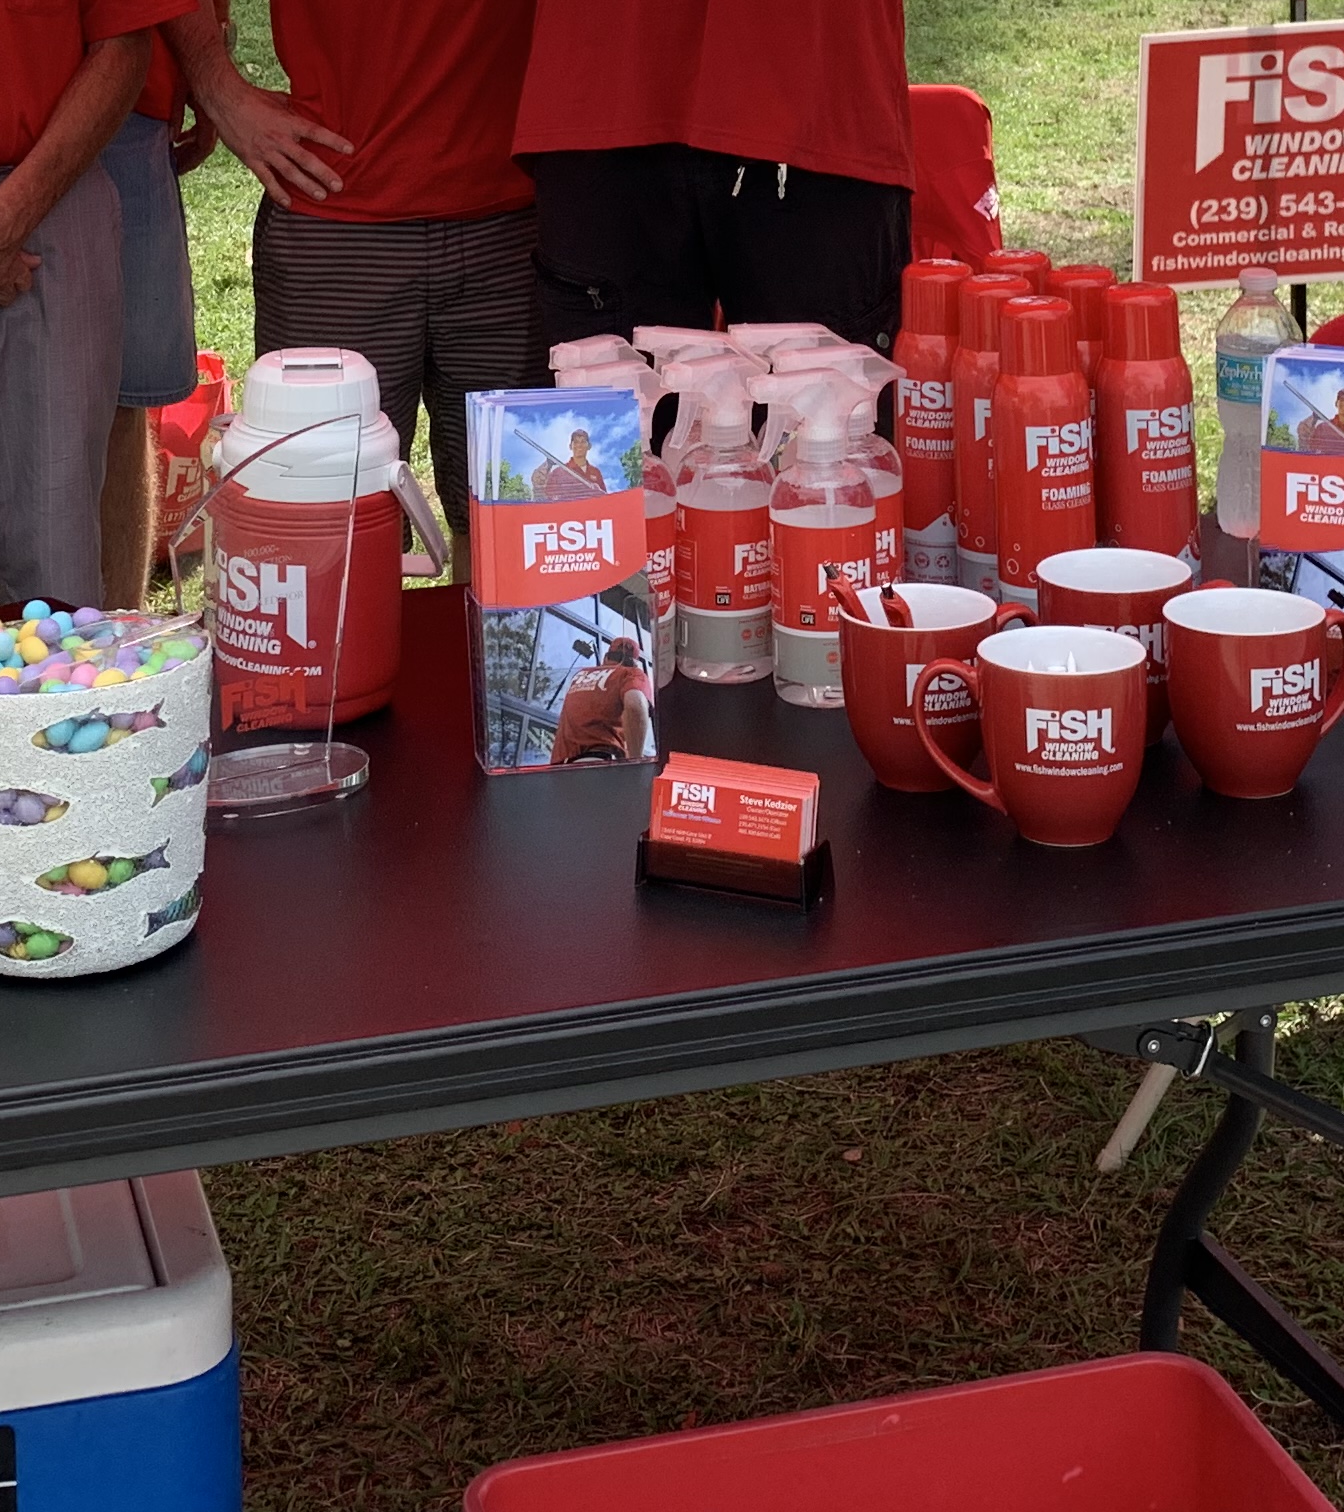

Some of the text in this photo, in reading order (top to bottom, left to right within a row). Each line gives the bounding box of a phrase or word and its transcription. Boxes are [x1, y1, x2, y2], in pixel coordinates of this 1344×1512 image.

[1190, 195, 1268, 229] (239)
[1172, 224, 1294, 247] Commercial
[1302, 222, 1316, 238] &
[1219, 360, 1262, 383] Zephyrh
[1146, 436, 1189, 450] WINDOW
[1141, 444, 1191, 460] CLEANING
[1046, 453, 1087, 468] WINDOW
[1041, 461, 1090, 477] CLEANING
[1142, 465, 1192, 484] FOAMING
[1041, 482, 1091, 502] FOAMING
[1142, 482, 1167, 493] GLASS
[544, 552, 596, 564] WINDOW
[646, 545, 676, 576] iSH
[539, 561, 600, 574] CLEANING
[924, 690, 969, 704] WINDOW
[1269, 693, 1310, 708] WINDOW
[1265, 700, 1312, 718] CLEANING
[1045, 742, 1095, 753] WINDOW
[1041, 751, 1099, 761] CLEANING
[1014, 762, 1124, 777] www.fishwindowcleaning.com
[739, 794, 763, 808] Steve
[764, 798, 798, 813] Kedzior
